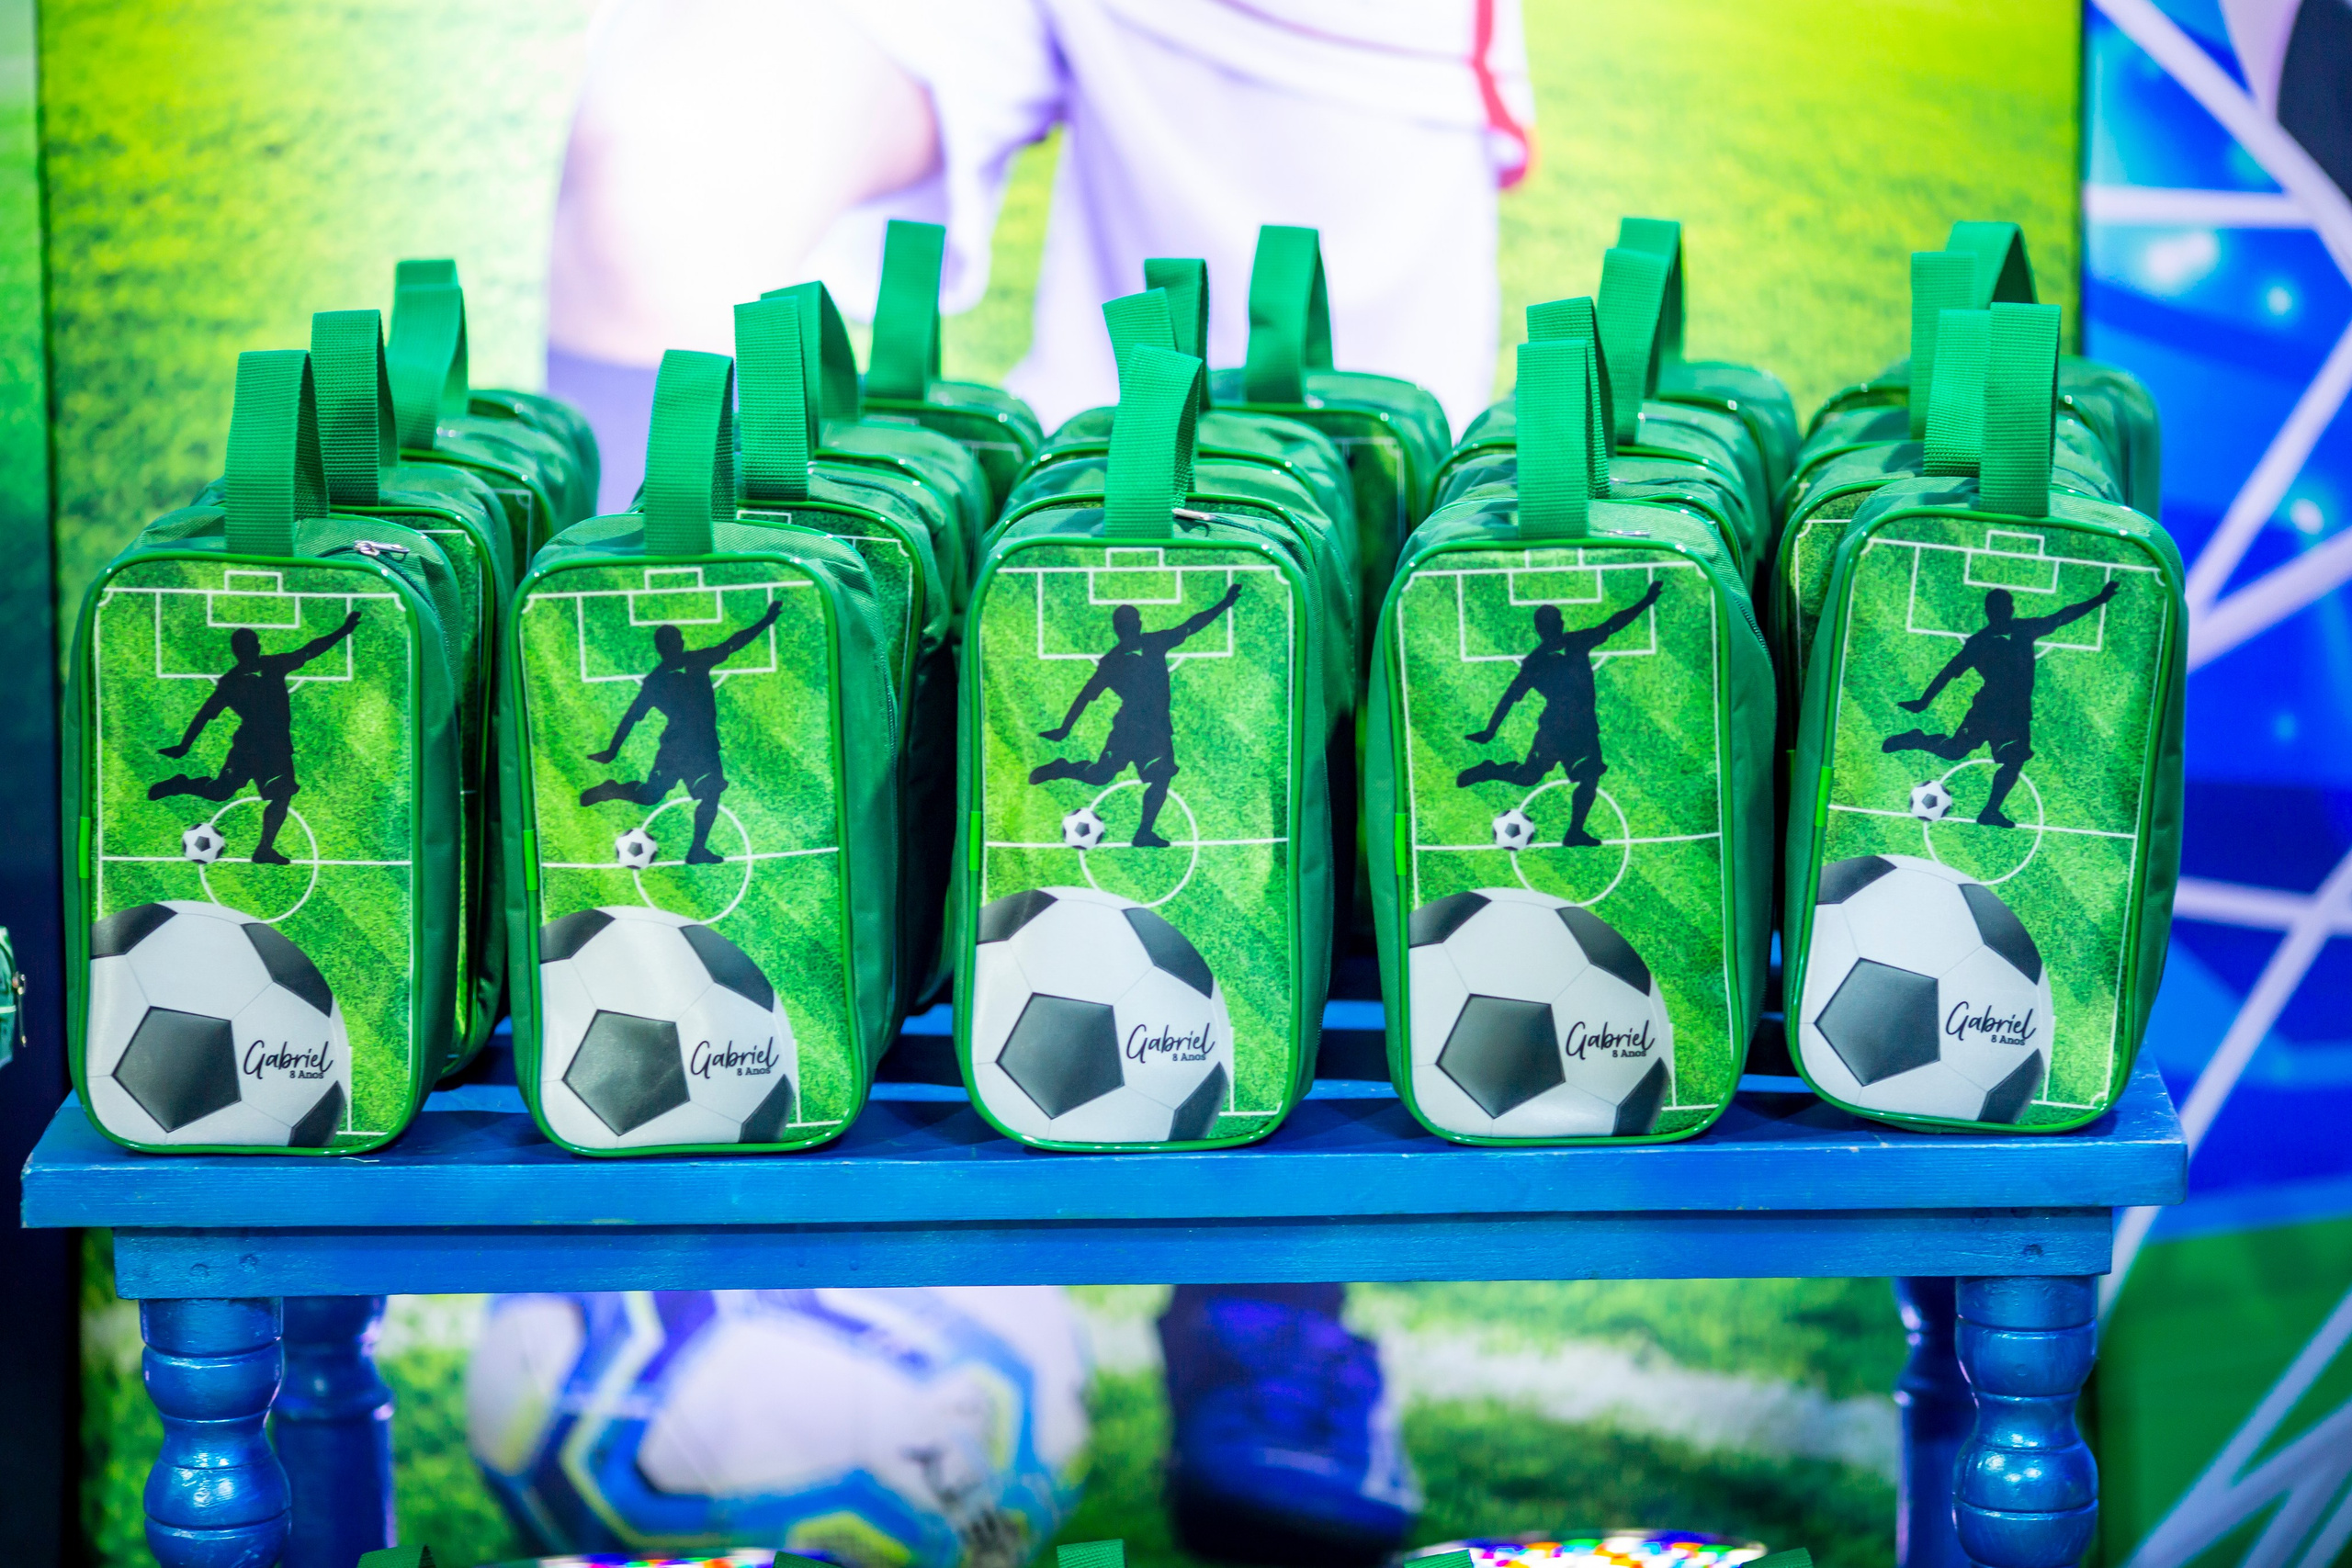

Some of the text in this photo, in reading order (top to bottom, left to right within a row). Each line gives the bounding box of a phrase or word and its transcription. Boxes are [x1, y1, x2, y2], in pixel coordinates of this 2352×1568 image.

[1945, 1000, 2037, 1042] Gabriel
[1125, 1022, 1216, 1064] Gabriel
[1566, 1019, 1656, 1061] Gabriel
[1990, 1034, 2026, 1046] 8 Anos
[243, 1039, 334, 1080] Gabriel
[690, 1036, 780, 1079] Gabriel
[1171, 1053, 1206, 1062] 8 Anos
[1611, 1049, 1646, 1058] 8 Anos
[288, 1070, 324, 1079] 8 Anos
[737, 1066, 771, 1077] 8 Anos
